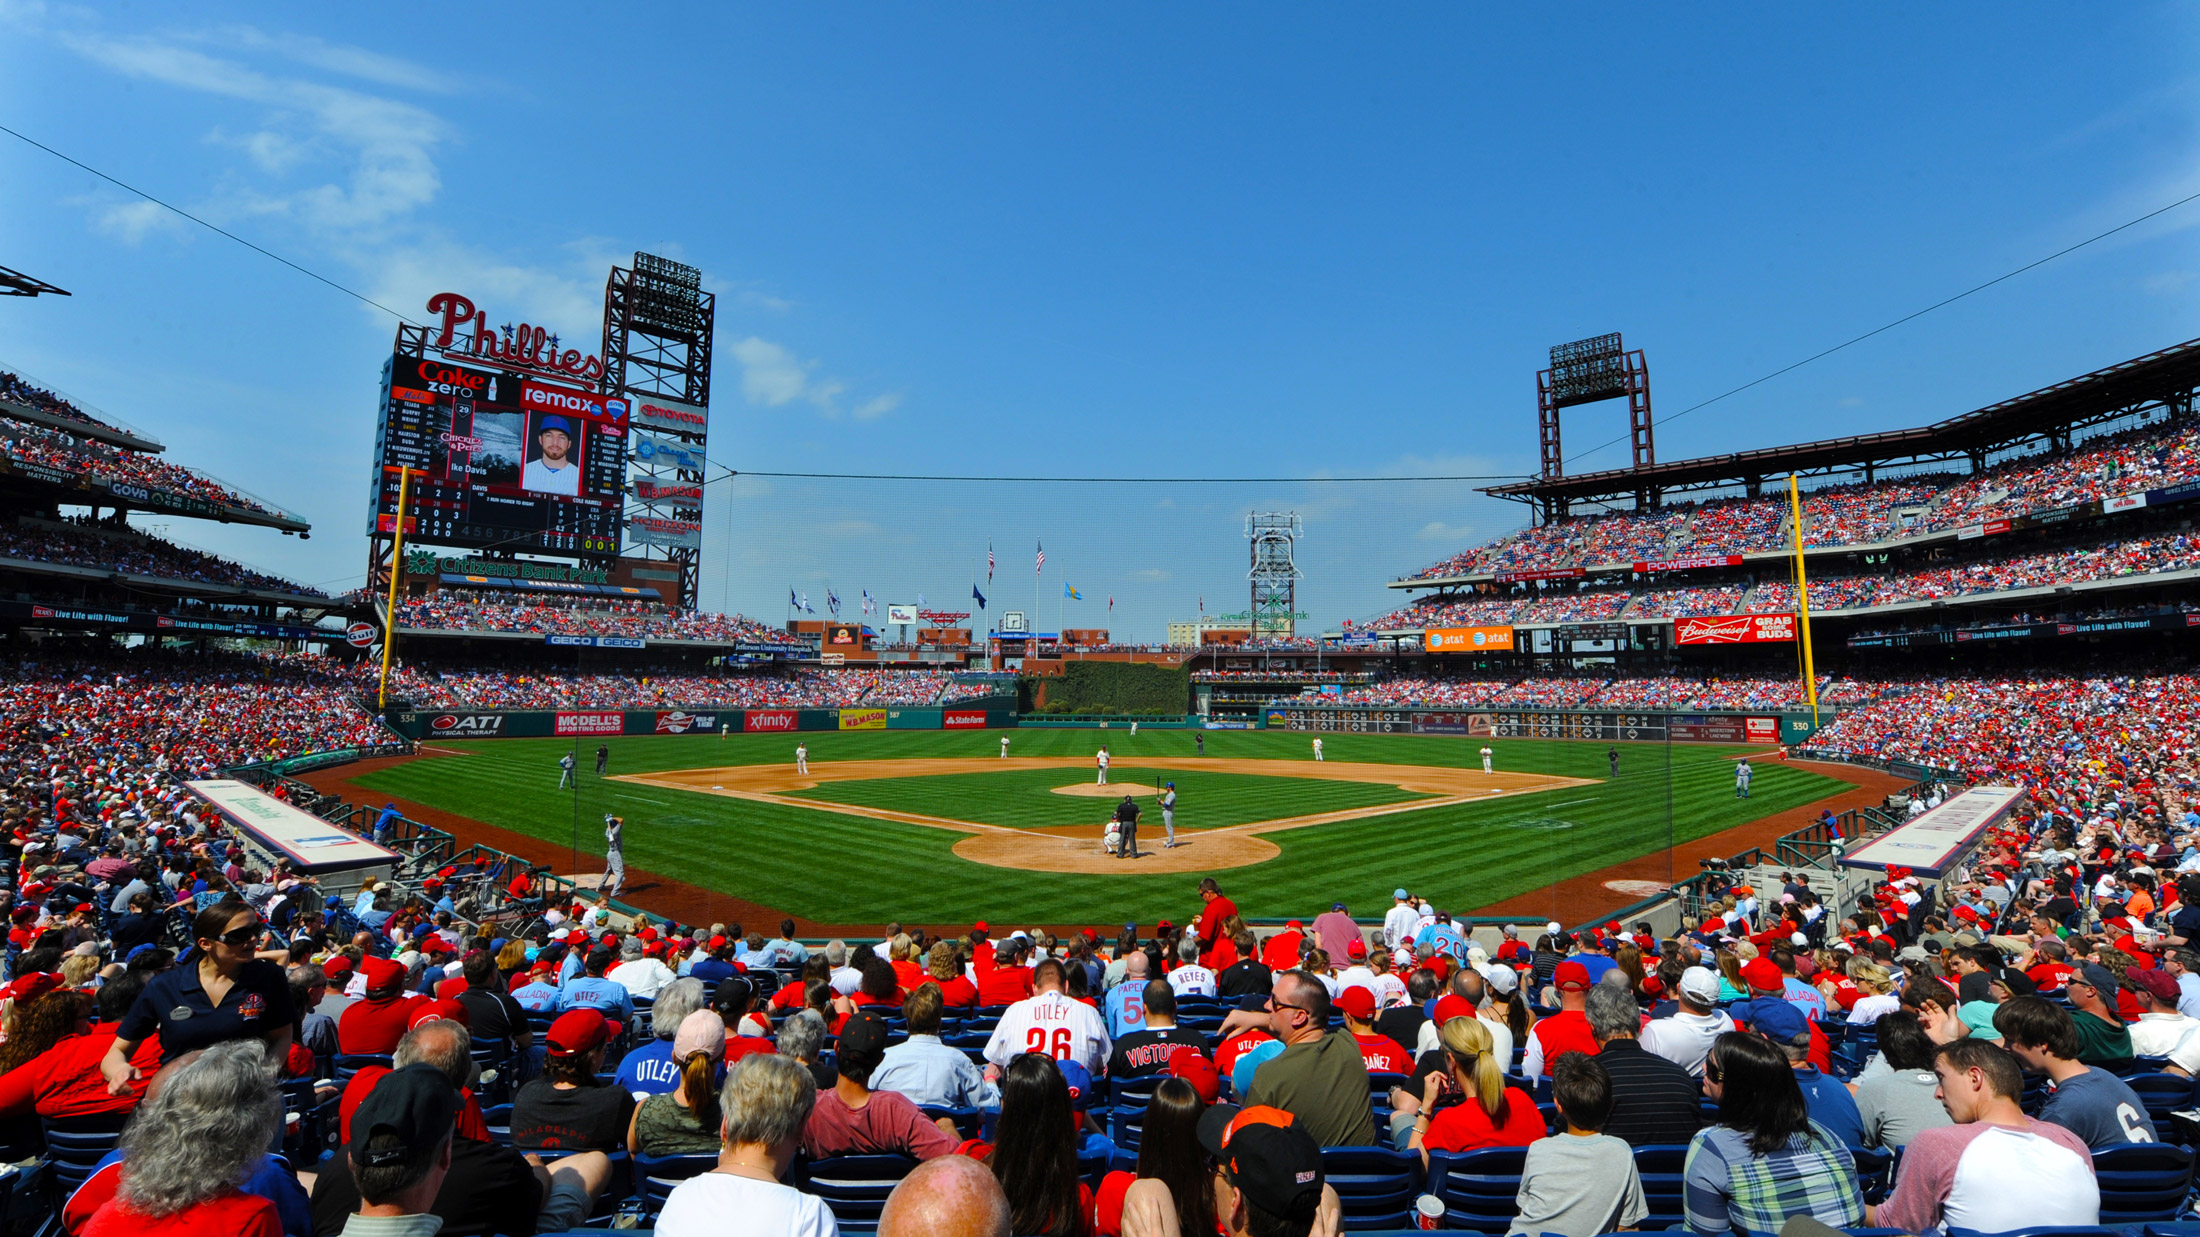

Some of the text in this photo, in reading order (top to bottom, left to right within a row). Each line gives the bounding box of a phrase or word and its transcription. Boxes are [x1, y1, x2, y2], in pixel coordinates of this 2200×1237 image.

[427, 292, 605, 379] Phillies
[417, 361, 484, 390] Coke
[428, 381, 473, 398] zero
[525, 388, 593, 412] remax
[657, 410, 705, 425] TOYOTA
[13, 462, 76, 480] RESPONSIBILITY
[451, 463, 487, 475] Ike Davis
[26, 472, 62, 484] MATTERS
[112, 484, 148, 500] GOYA
[436, 489, 441, 497] 2
[434, 509, 439, 517] 0
[2030, 506, 2079, 521] RESPONSIBILITY
[2042, 514, 2070, 523] MATTERS
[632, 516, 701, 531] HORIZON
[1984, 523, 2004, 531] Canon
[585, 540, 614, 551] 0 0 1
[1647, 557, 1728, 571] POWERADE
[440, 557, 607, 584] Citizens Bank Park
[55, 610, 128, 623] Live Life with Flavor!
[1241, 611, 1280, 619] Citizens
[1283, 611, 1308, 619] Bank
[214, 623, 234, 631] Flavor!
[1264, 622, 1284, 630] Park
[1755, 617, 1792, 626] GRAB
[2076, 620, 2150, 632] Live Life with Flavor!
[348, 629, 374, 640] Gulf
[1680, 624, 1749, 636] Budweiser
[1756, 630, 1793, 639] BUDS
[2010, 629, 2031, 637] Flavor!
[550, 636, 640, 647] GEICO GEICO
[1444, 632, 1508, 644] at&t at&t
[736, 643, 760, 651] Jefferson
[788, 645, 812, 653] Hospitals
[400, 714, 415, 723] 334
[455, 716, 502, 729] ATI
[558, 714, 621, 726] MODELL'S
[751, 716, 792, 731] xfinity
[1793, 722, 1809, 730] 330
[1435, 937, 1463, 960] 20
[1178, 971, 1206, 984] REYES
[574, 992, 600, 1002] UTLEY
[1034, 1004, 1069, 1020] UTLEY
[1123, 997, 1143, 1024] 5
[1026, 1027, 1071, 1060] 26
[636, 1059, 680, 1084] UTLEY
